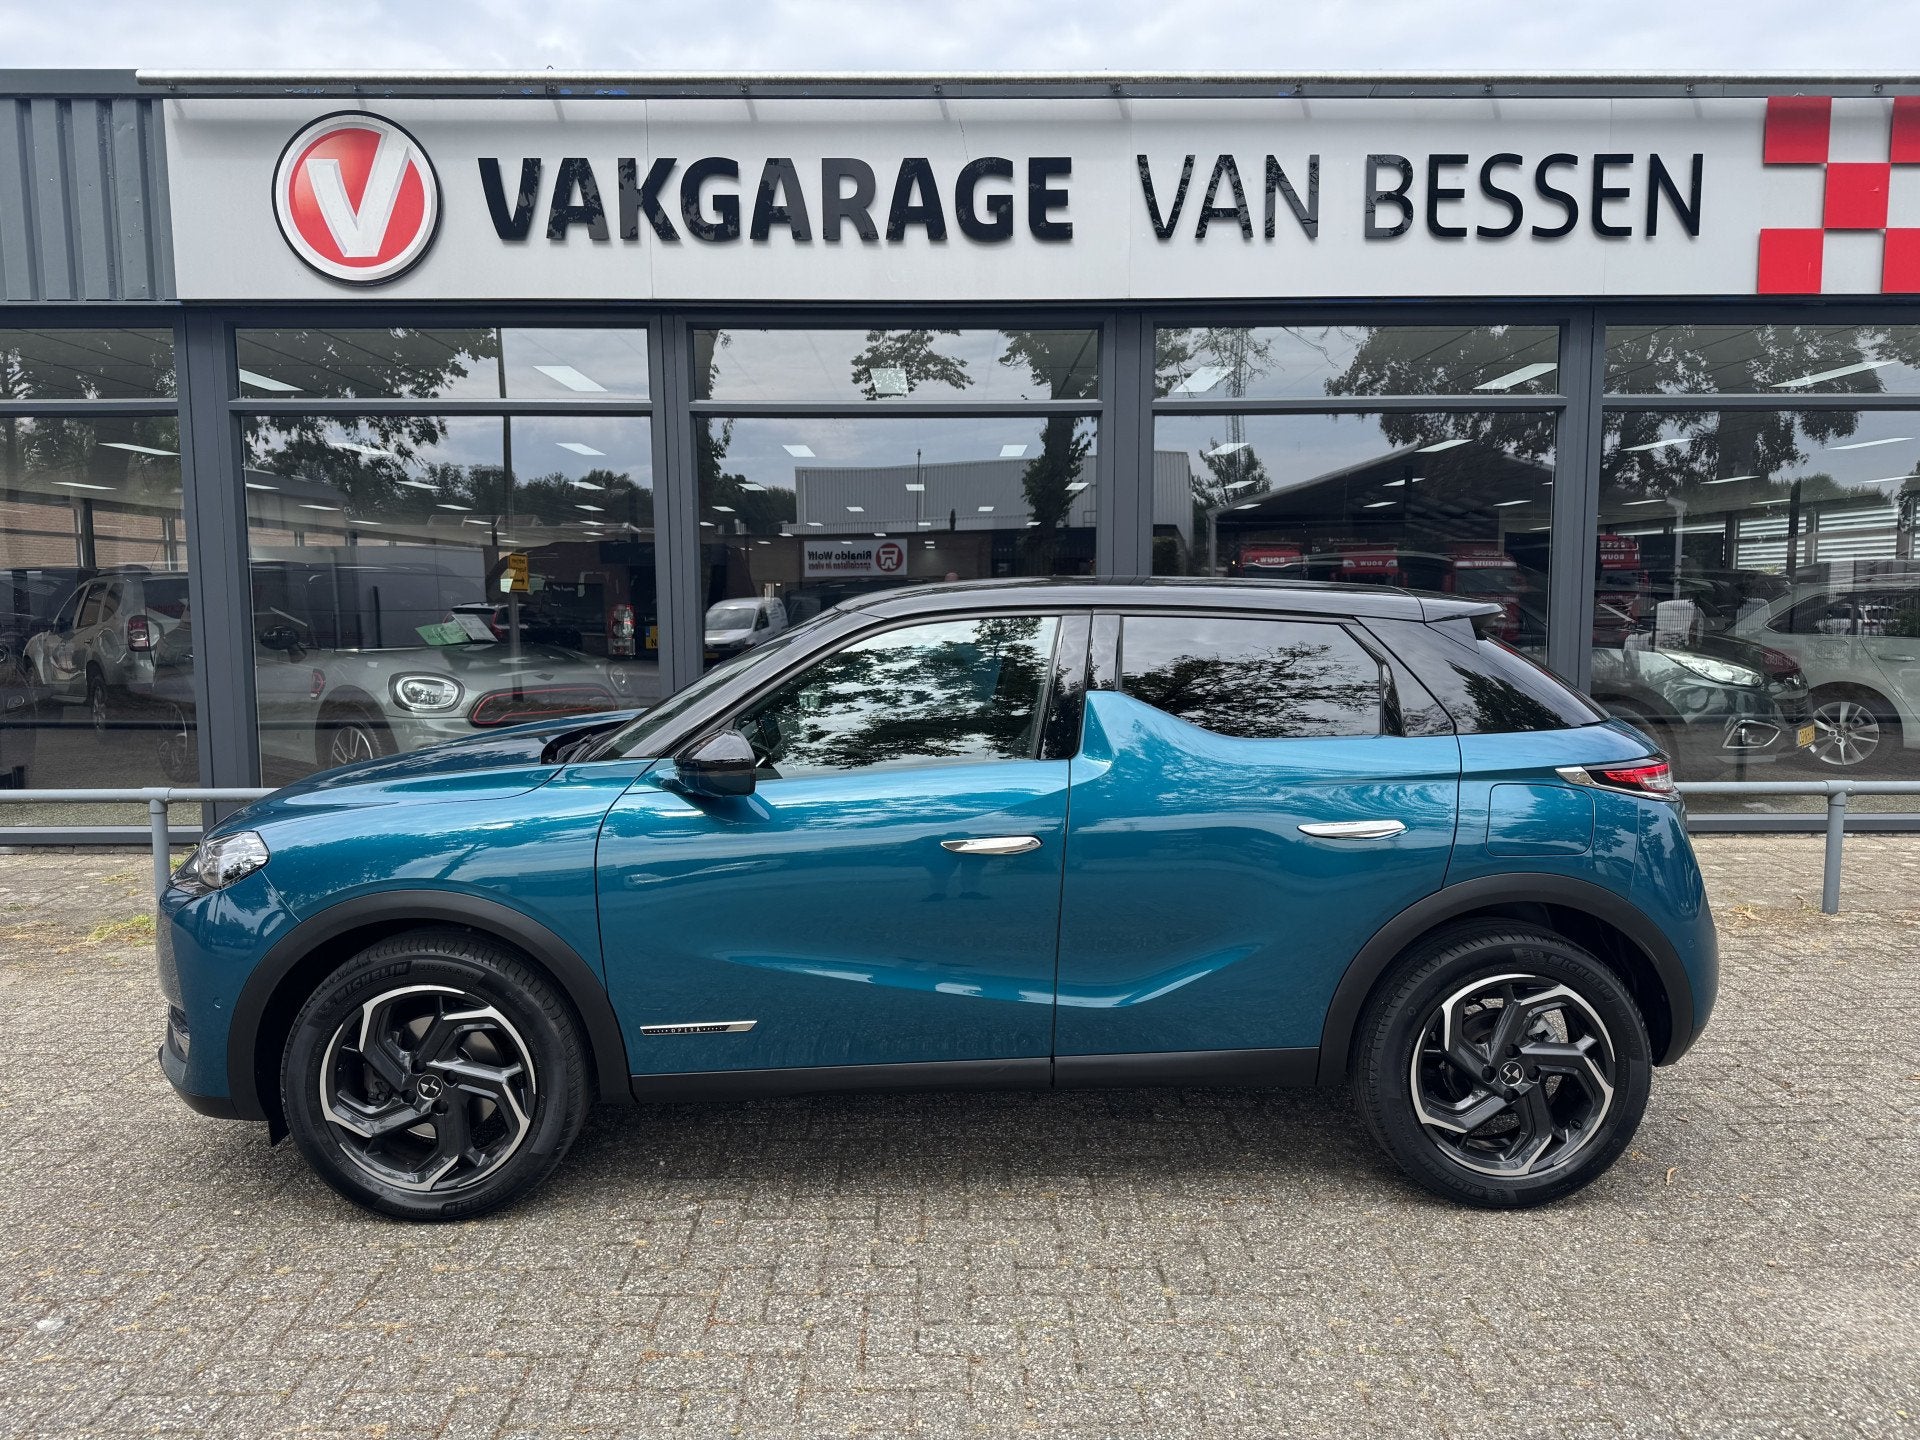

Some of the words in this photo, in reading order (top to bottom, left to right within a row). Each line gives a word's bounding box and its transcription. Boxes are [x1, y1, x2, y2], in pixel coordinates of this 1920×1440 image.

[478, 156, 1074, 243] VAKGARAGE
[1137, 153, 1321, 240] VAN
[1364, 152, 1704, 240] BESSEN
[333, 960, 409, 1004] MICHELIN
